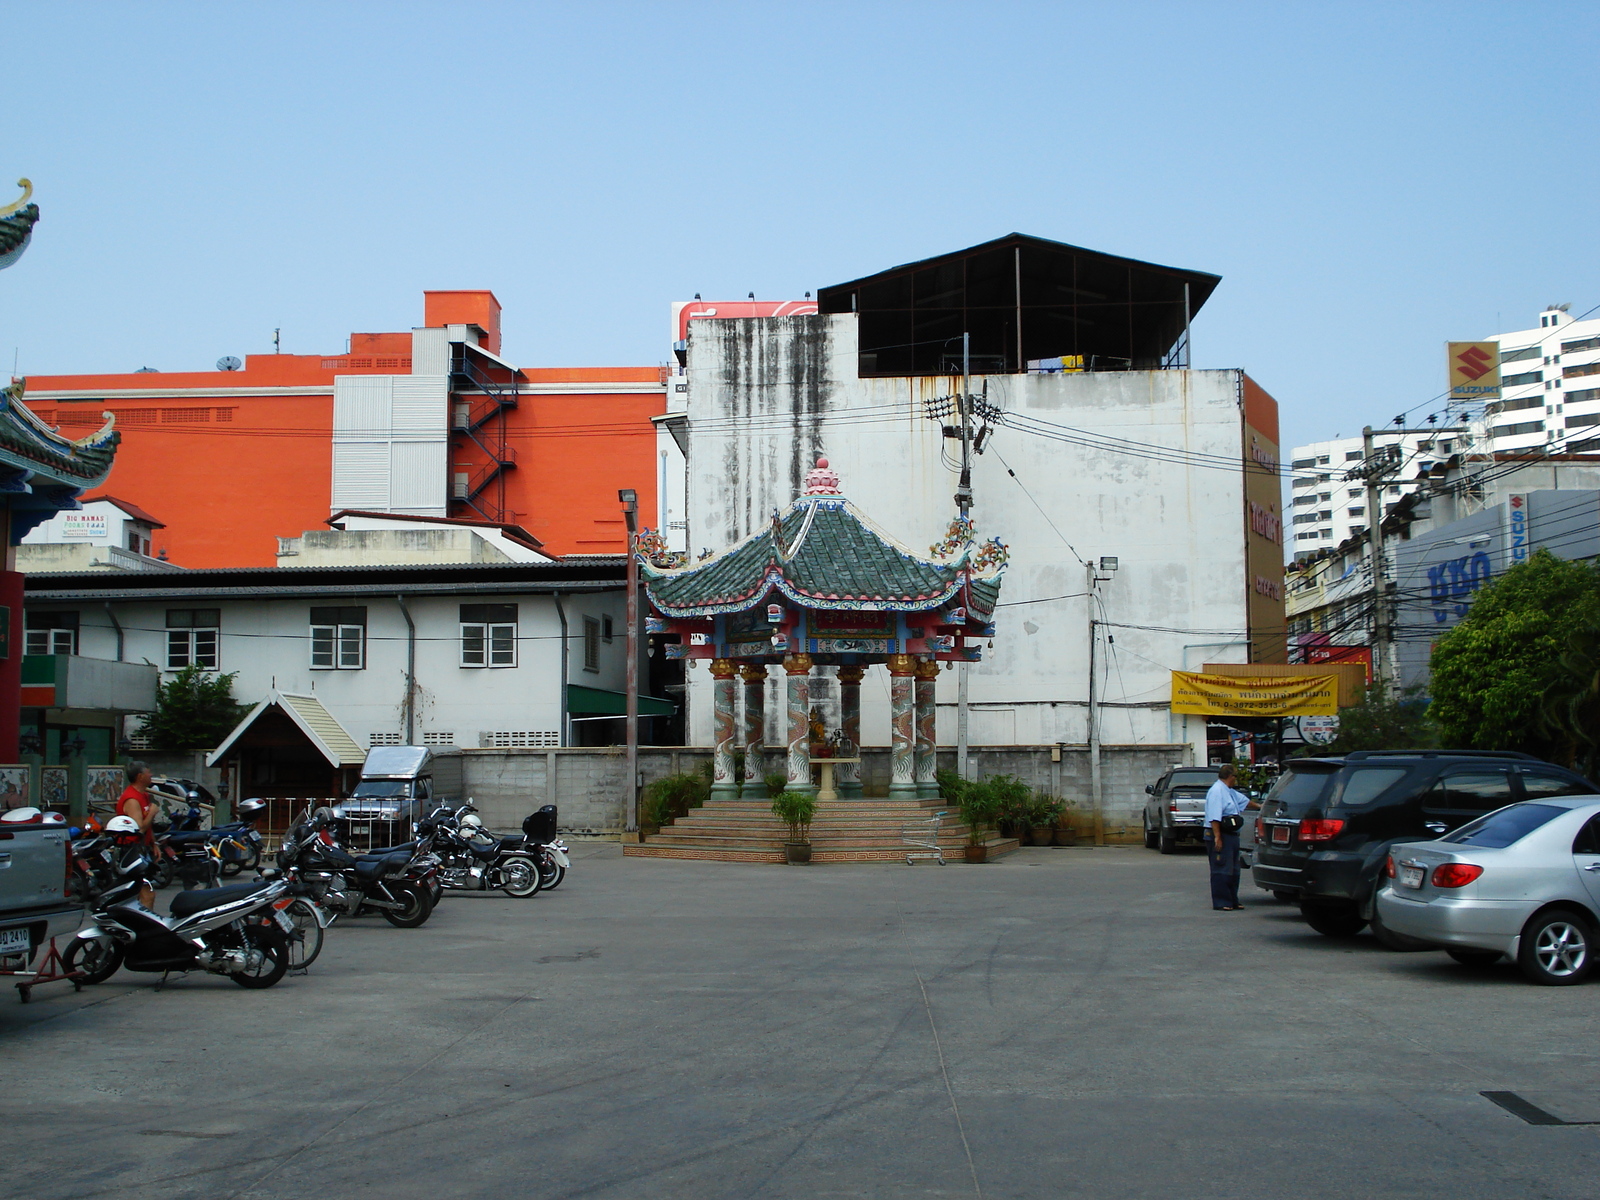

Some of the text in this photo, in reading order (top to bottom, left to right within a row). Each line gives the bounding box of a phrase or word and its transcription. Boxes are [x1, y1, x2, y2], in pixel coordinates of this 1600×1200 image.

[1453, 386, 1500, 394] SUZUKI
[1511, 510, 1526, 564] SUZU
[10, 929, 28, 942] 2410
